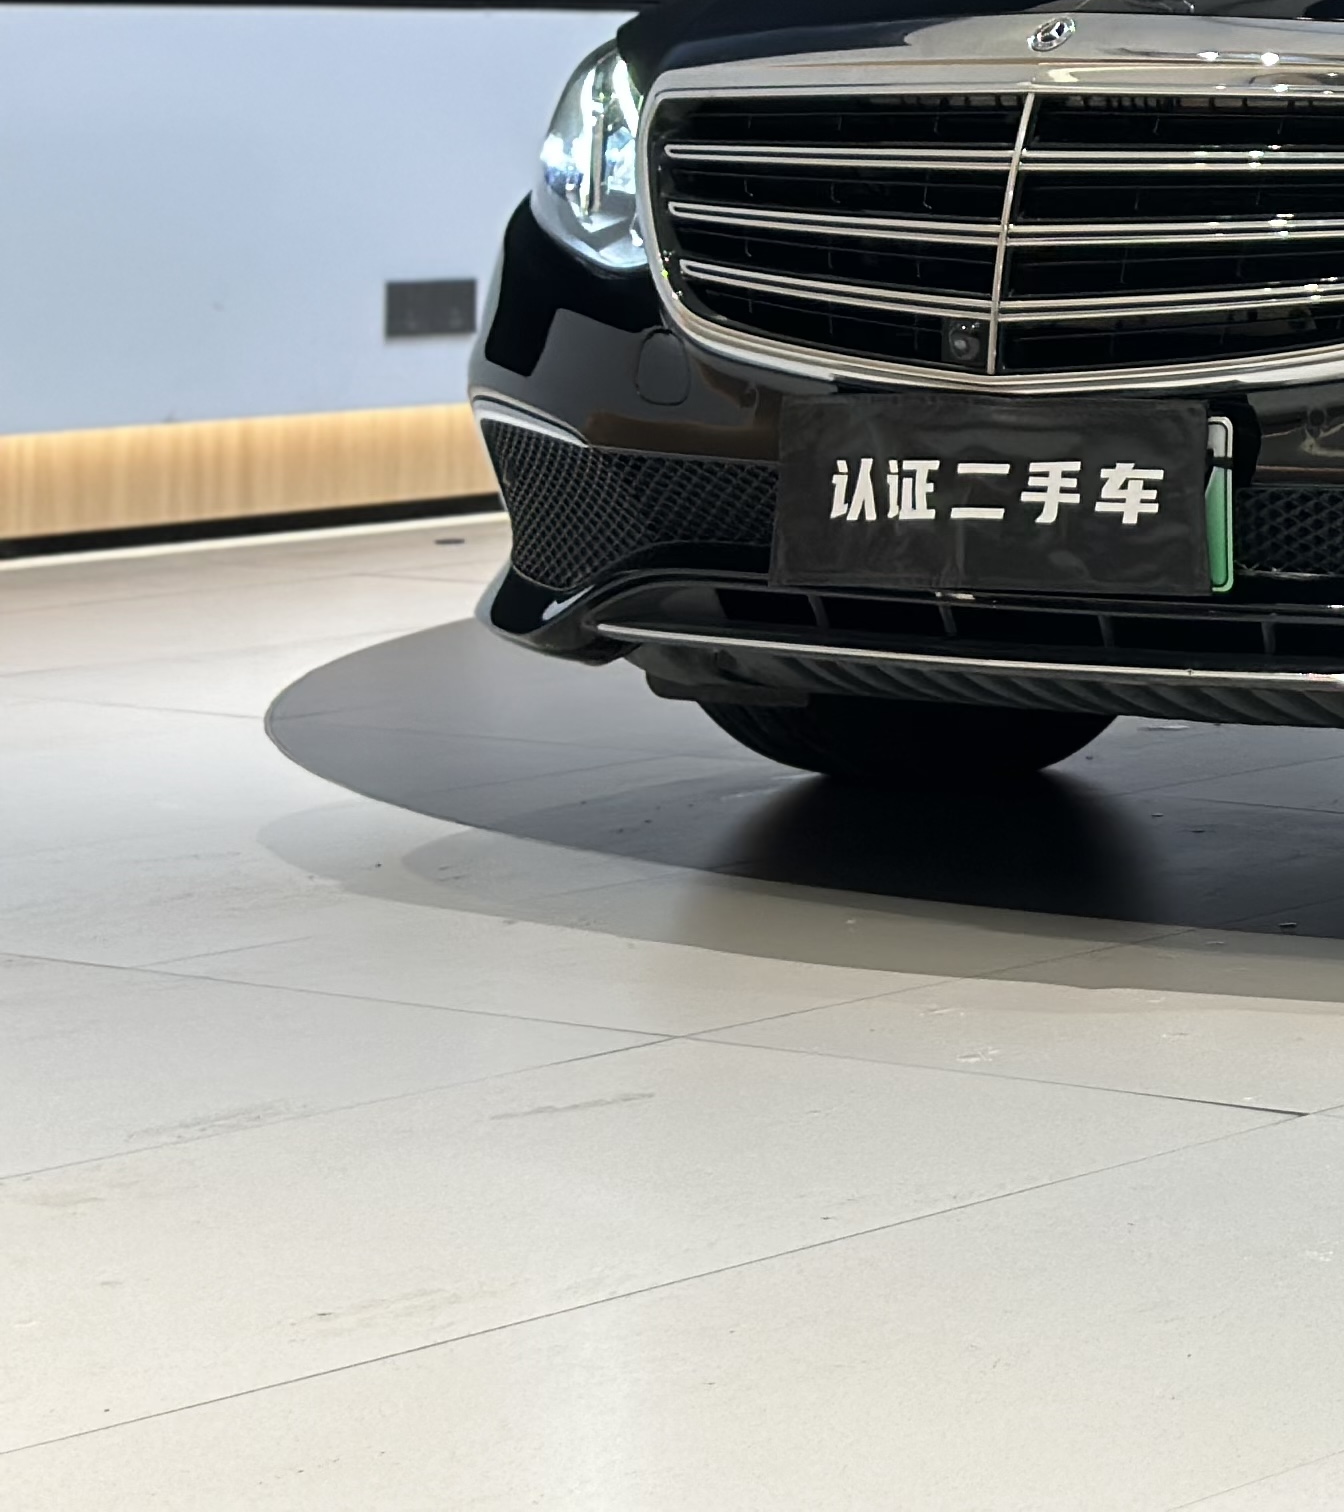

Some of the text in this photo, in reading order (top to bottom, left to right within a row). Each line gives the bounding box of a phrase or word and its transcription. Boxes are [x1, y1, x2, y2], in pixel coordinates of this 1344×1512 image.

[829, 457, 1165, 525] 认证二手车
